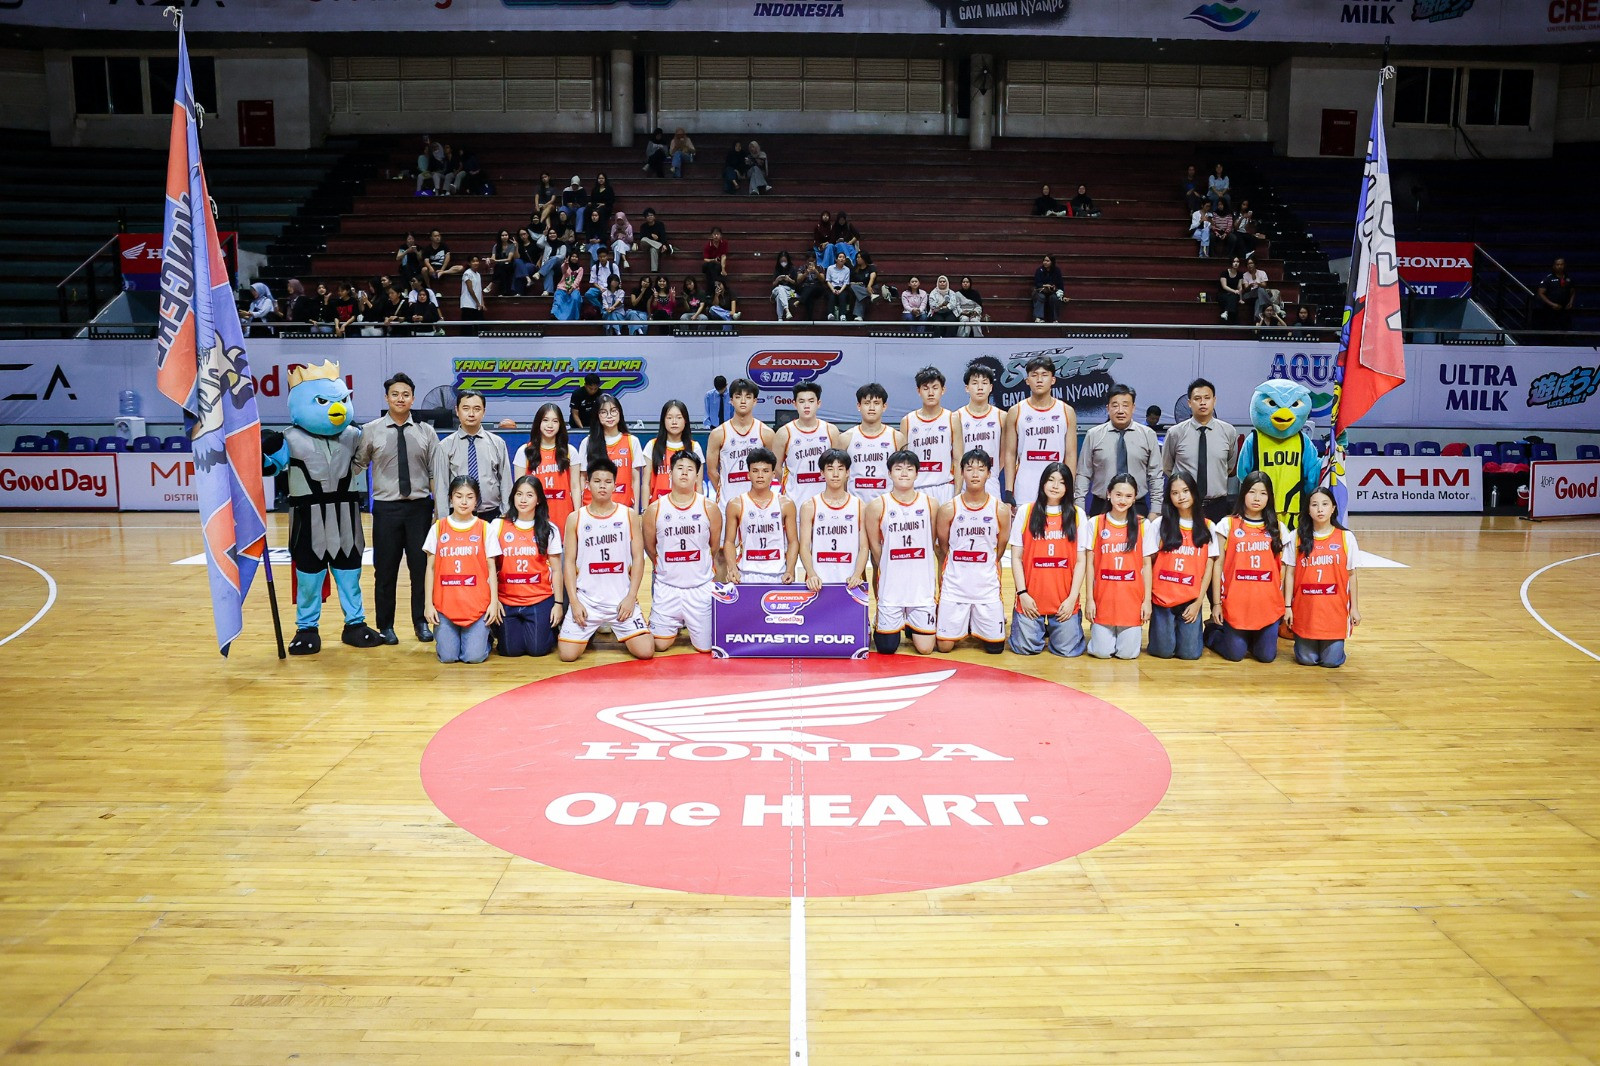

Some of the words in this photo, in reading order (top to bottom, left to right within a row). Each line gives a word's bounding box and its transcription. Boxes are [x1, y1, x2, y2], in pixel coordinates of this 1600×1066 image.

[753, 3, 844, 17] INDONESIA
[959, 5, 982, 20] GAYA
[986, 2, 1018, 17] MAKIN
[1341, 4, 1395, 24] MILK
[1548, 0, 1600, 24] CRE
[1396, 256, 1472, 268] HONDA
[454, 360, 496, 372] YANG
[498, 360, 553, 372] WORTH
[577, 360, 598, 372] YA
[598, 360, 642, 372] CUMA
[1000, 352, 1124, 389] SREET
[771, 372, 795, 382] DBL
[1439, 364, 1518, 387] ULTRA
[1002, 391, 1026, 408] GAYA
[1446, 389, 1509, 412] MILK
[1038, 438, 1047, 450] 77
[923, 448, 932, 460] 19
[1263, 450, 1300, 467] LOUI
[809, 460, 815, 472] 11
[866, 466, 876, 477] 22
[544, 476, 554, 488] 14
[1358, 468, 1470, 486] AHM
[1554, 476, 1598, 500] Good
[1356, 490, 1368, 500] PT
[1372, 490, 1398, 500] Astra
[1402, 490, 1434, 500] Honda
[1438, 490, 1470, 500] Motor
[680, 538, 686, 550] 8
[832, 538, 837, 551] 3
[902, 534, 912, 547] 14
[970, 538, 975, 550] 7
[600, 548, 610, 562] 15
[1048, 544, 1055, 556] 8
[454, 560, 462, 574] 3
[516, 560, 528, 572] 22
[1114, 556, 1124, 570] 17
[1174, 558, 1184, 572] 15
[1250, 556, 1260, 568] 13
[1316, 569, 1322, 582] 7
[632, 618, 644, 630] 15
[927, 613, 935, 626] 14
[726, 634, 810, 644] FANTASTIC
[814, 634, 855, 644] FOUR
[573, 741, 1015, 762] HONDA
[544, 792, 721, 827] One
[741, 794, 1050, 827] HEART.
